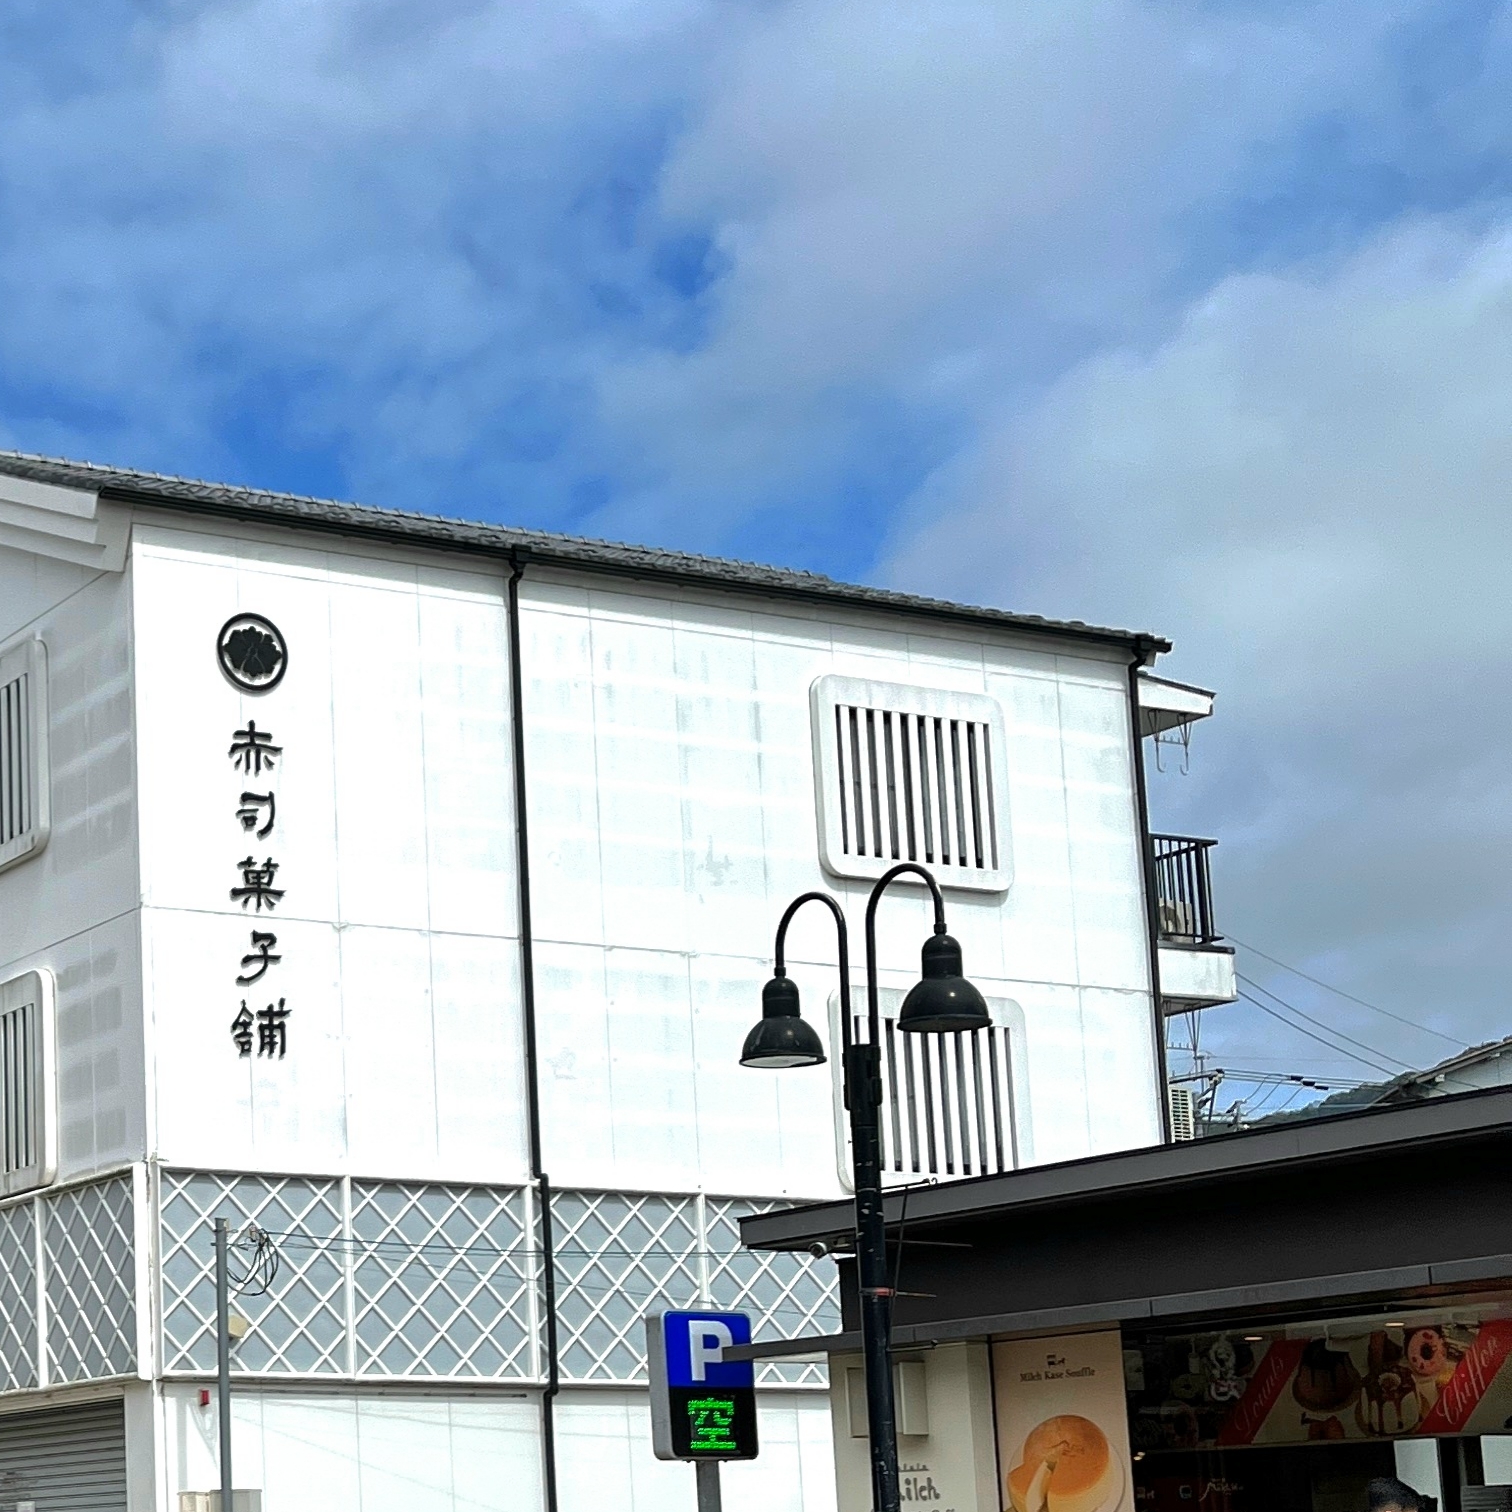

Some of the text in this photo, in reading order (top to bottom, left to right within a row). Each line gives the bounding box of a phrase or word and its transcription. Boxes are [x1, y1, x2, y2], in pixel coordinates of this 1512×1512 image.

[229, 719, 291, 1061] 赤司菓子舗
[688, 1319, 734, 1382] P
[687, 1397, 737, 1450] 空
